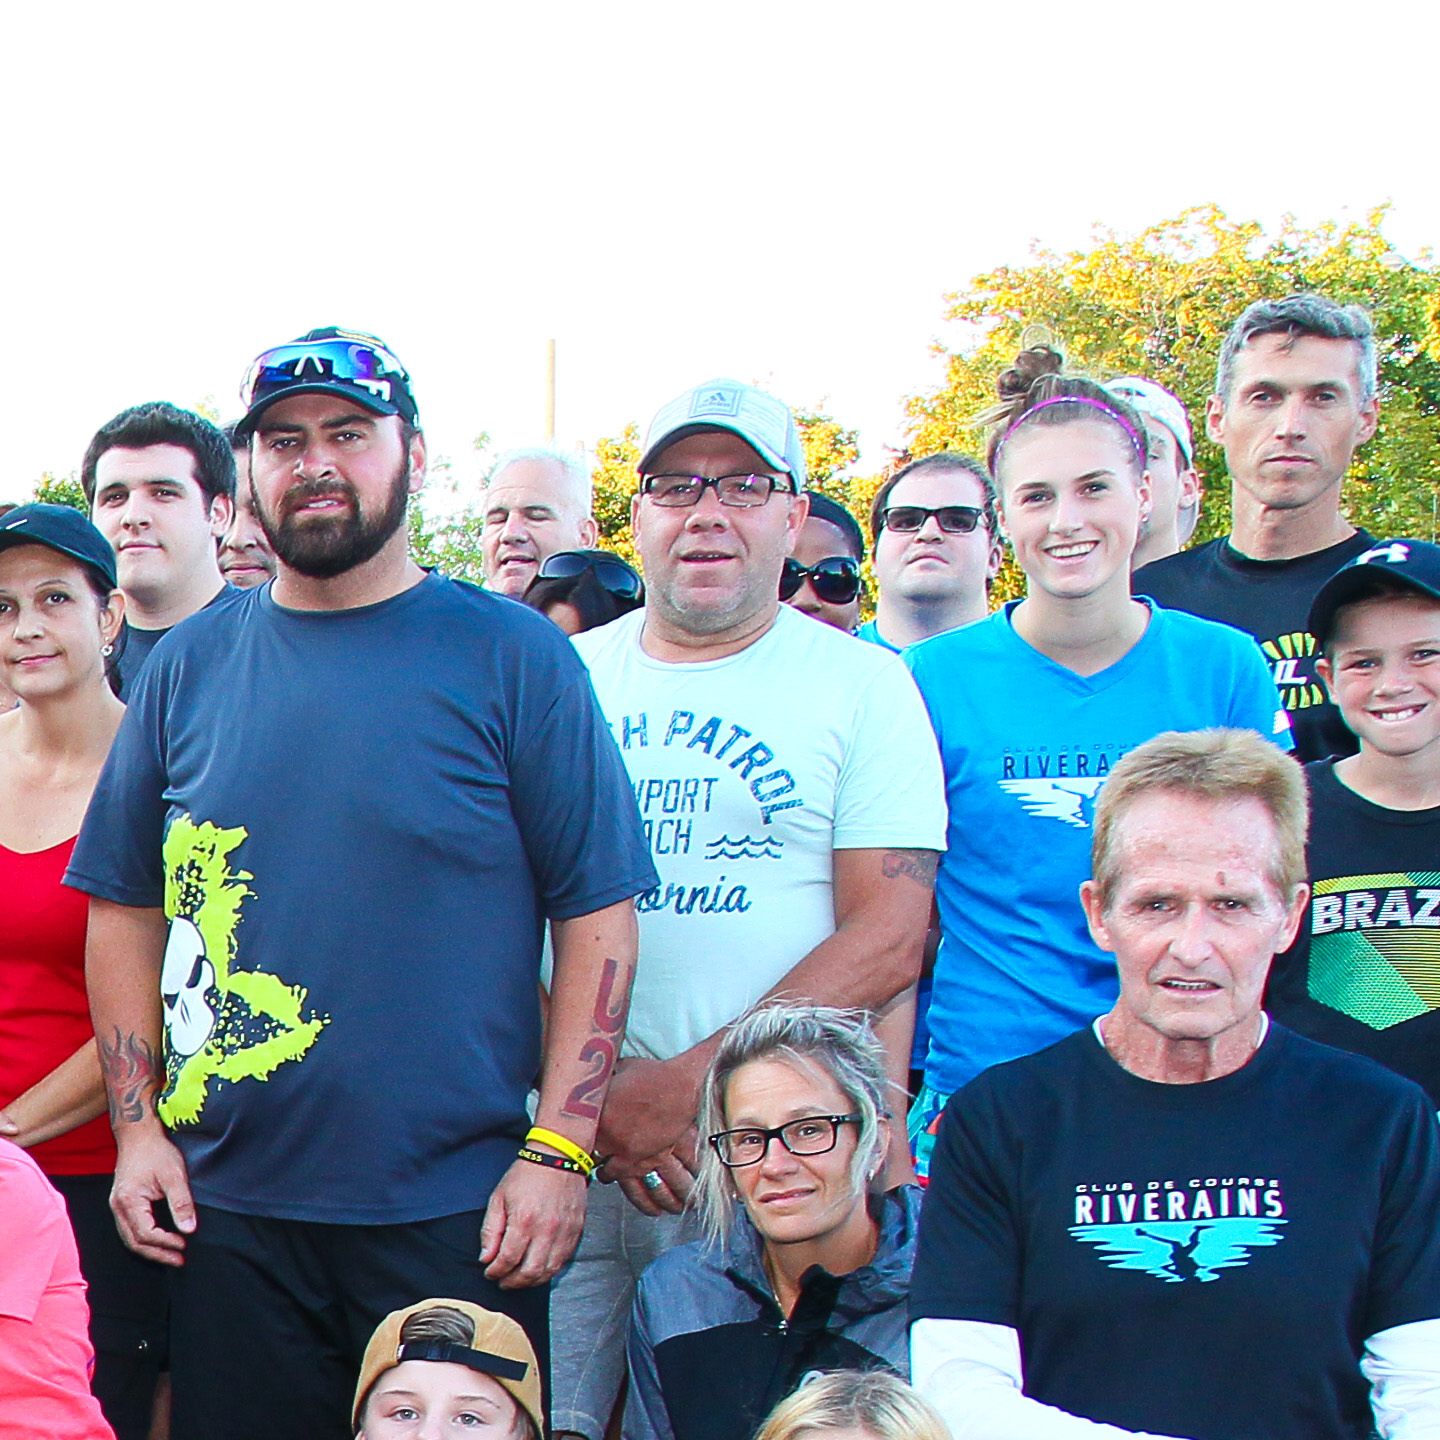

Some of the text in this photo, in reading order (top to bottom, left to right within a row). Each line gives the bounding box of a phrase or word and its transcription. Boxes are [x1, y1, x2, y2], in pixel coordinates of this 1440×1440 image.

[663, 710, 804, 825] PATROL
[1003, 752, 1123, 779] RIVERA
[635, 876, 752, 914] ornia
[1075, 1178, 1280, 1193] CLUB DE COURSE
[1074, 1188, 1283, 1224] RIVERAINS
